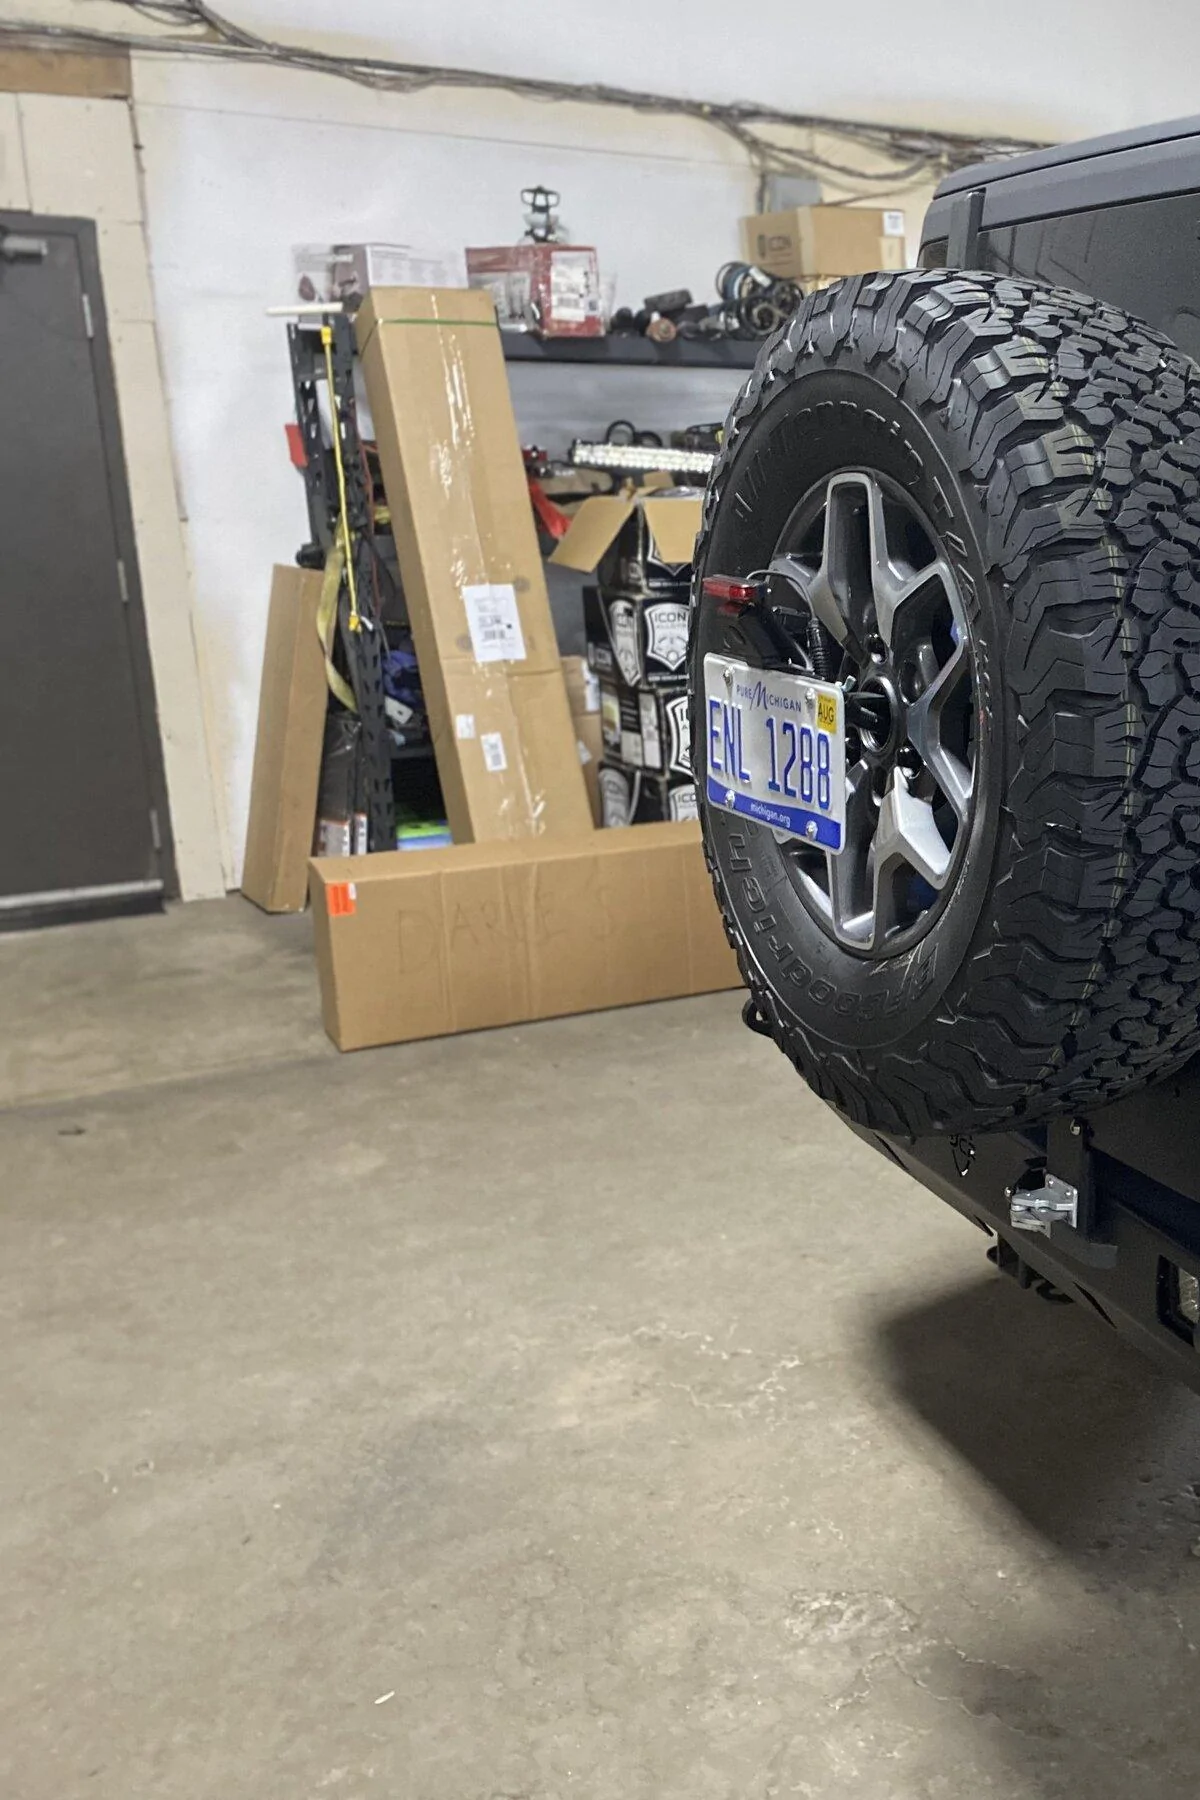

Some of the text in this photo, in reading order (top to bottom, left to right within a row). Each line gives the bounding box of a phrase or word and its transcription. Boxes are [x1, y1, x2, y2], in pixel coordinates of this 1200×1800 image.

[654, 611, 686, 623] ICON
[736, 684, 753, 700] PURE
[817, 702, 835, 723] AUG
[708, 699, 751, 782] ENL
[765, 716, 831, 811] 1288
[750, 802, 791, 829] michigan.org
